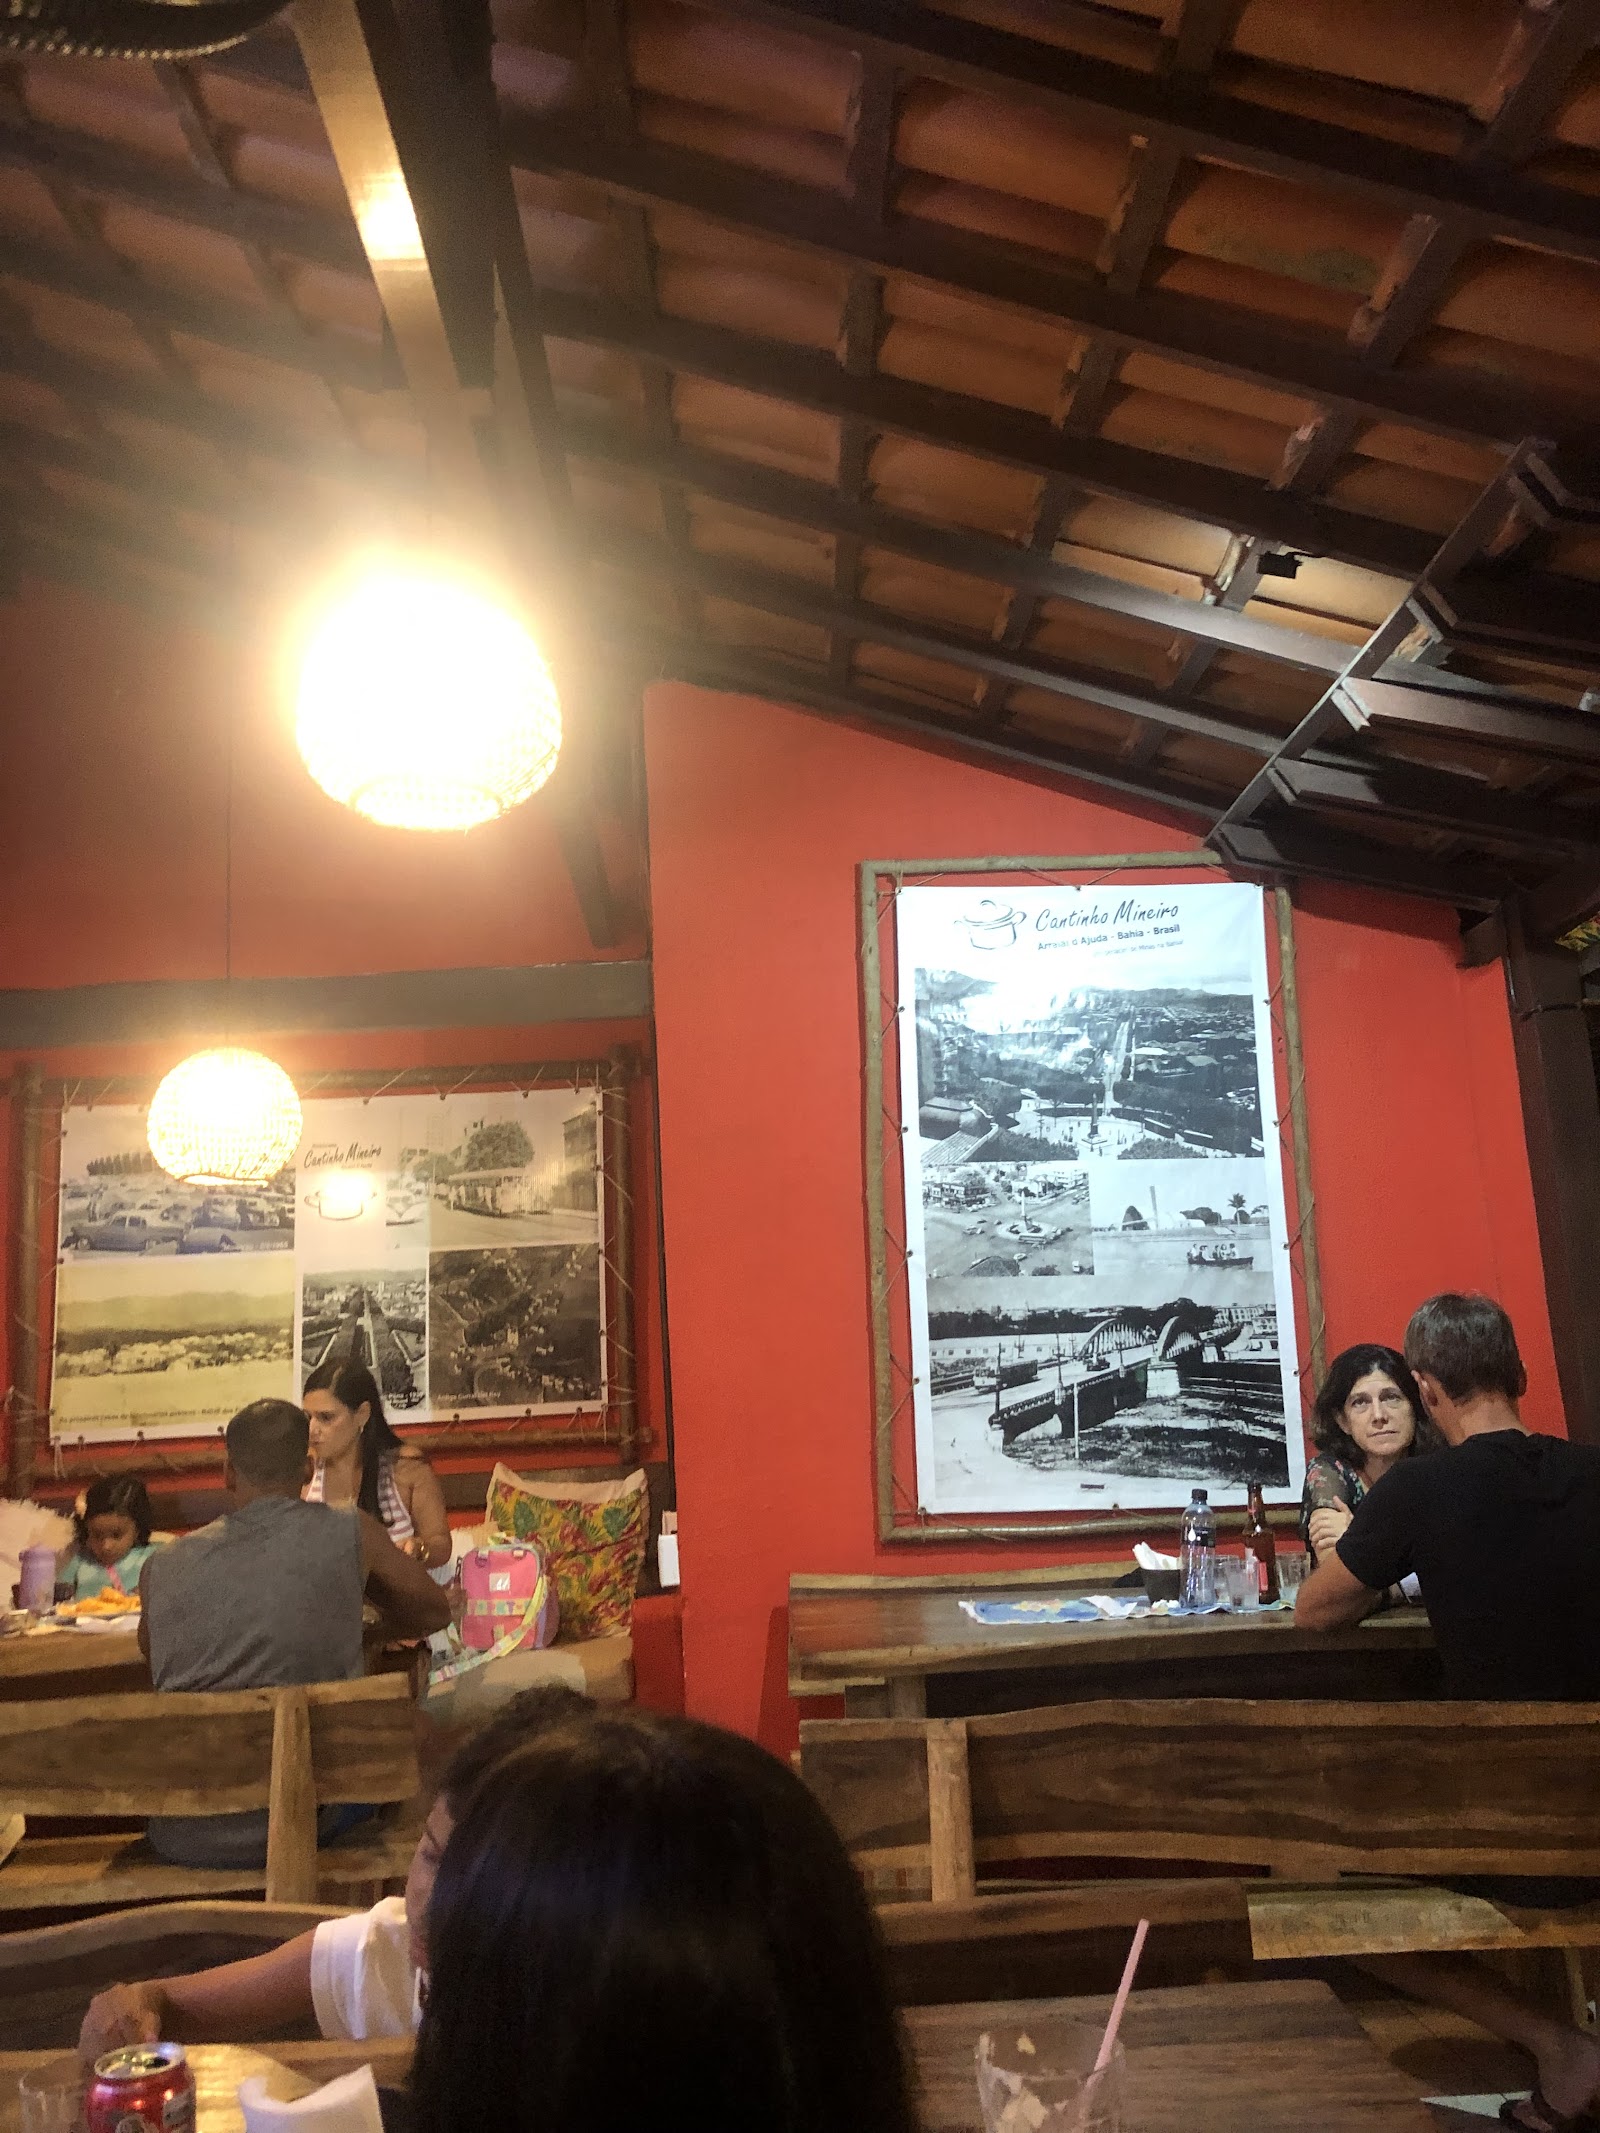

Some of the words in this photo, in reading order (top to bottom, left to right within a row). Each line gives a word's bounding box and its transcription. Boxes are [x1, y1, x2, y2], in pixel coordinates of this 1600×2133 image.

[1035, 905, 1108, 931] Cantinho
[1113, 899, 1178, 925] Mineiro
[1117, 929, 1144, 940] Bahia
[1153, 924, 1180, 935] Brasil
[303, 1146, 344, 1169] Cantinho
[345, 1142, 381, 1162] Mineiro
